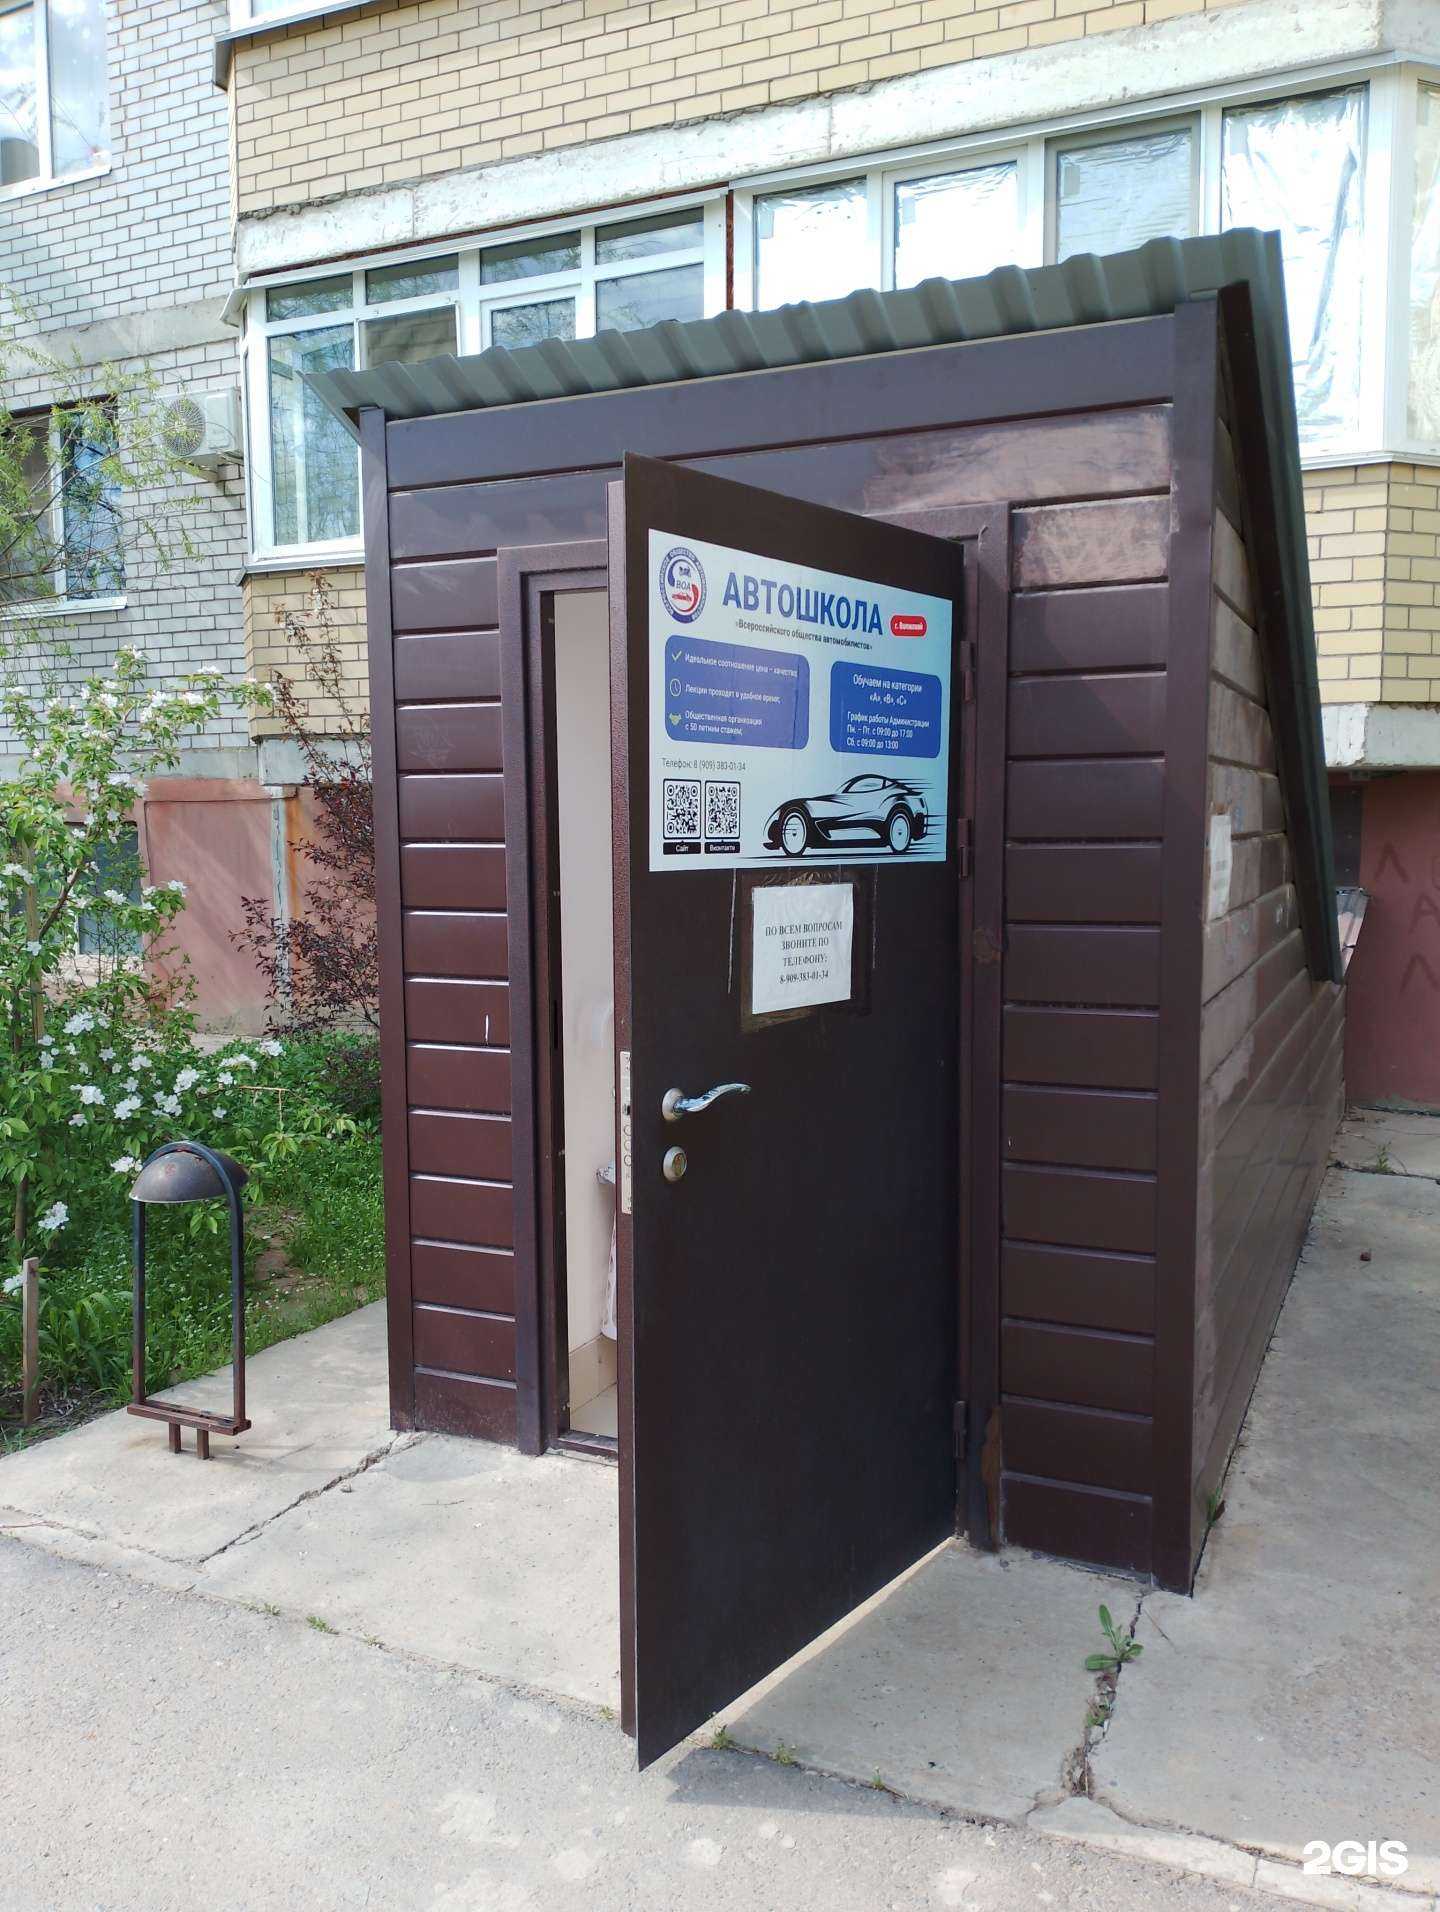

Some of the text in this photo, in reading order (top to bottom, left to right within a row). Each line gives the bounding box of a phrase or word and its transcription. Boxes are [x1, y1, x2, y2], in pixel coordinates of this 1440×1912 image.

[676, 580, 691, 590] ВОА
[722, 572, 883, 636] АВТОШКОЛА
[791, 629, 822, 642] общества
[684, 653, 717, 666] Идеальное
[685, 684, 708, 696] Лекции
[853, 673, 923, 694] Обучаем на категории
[847, 711, 930, 729] График работы Администрации
[690, 722, 698, 731] 50
[698, 724, 720, 733] летним
[847, 724, 857, 734] Пн.
[876, 726, 891, 737] 09:00
[891, 730, 899, 738] до
[899, 729, 913, 738] 17:00
[860, 738, 876, 748] 09:00
[876, 741, 884, 749] до
[884, 740, 899, 750] 13:00
[662, 757, 692, 770] Телефон:
[699, 759, 716, 772] (909)
[716, 760, 747, 771] 383-01-34
[675, 844, 689, 853] Сайт
[765, 920, 843, 937] ПО ВСЕМ ВОПРОСАМ
[782, 936, 829, 951] ЗВОНИТЕ ПО
[783, 953, 828, 967] ТЕЛЕФОНУ:
[779, 969, 829, 985] 8-909-383-01-34
